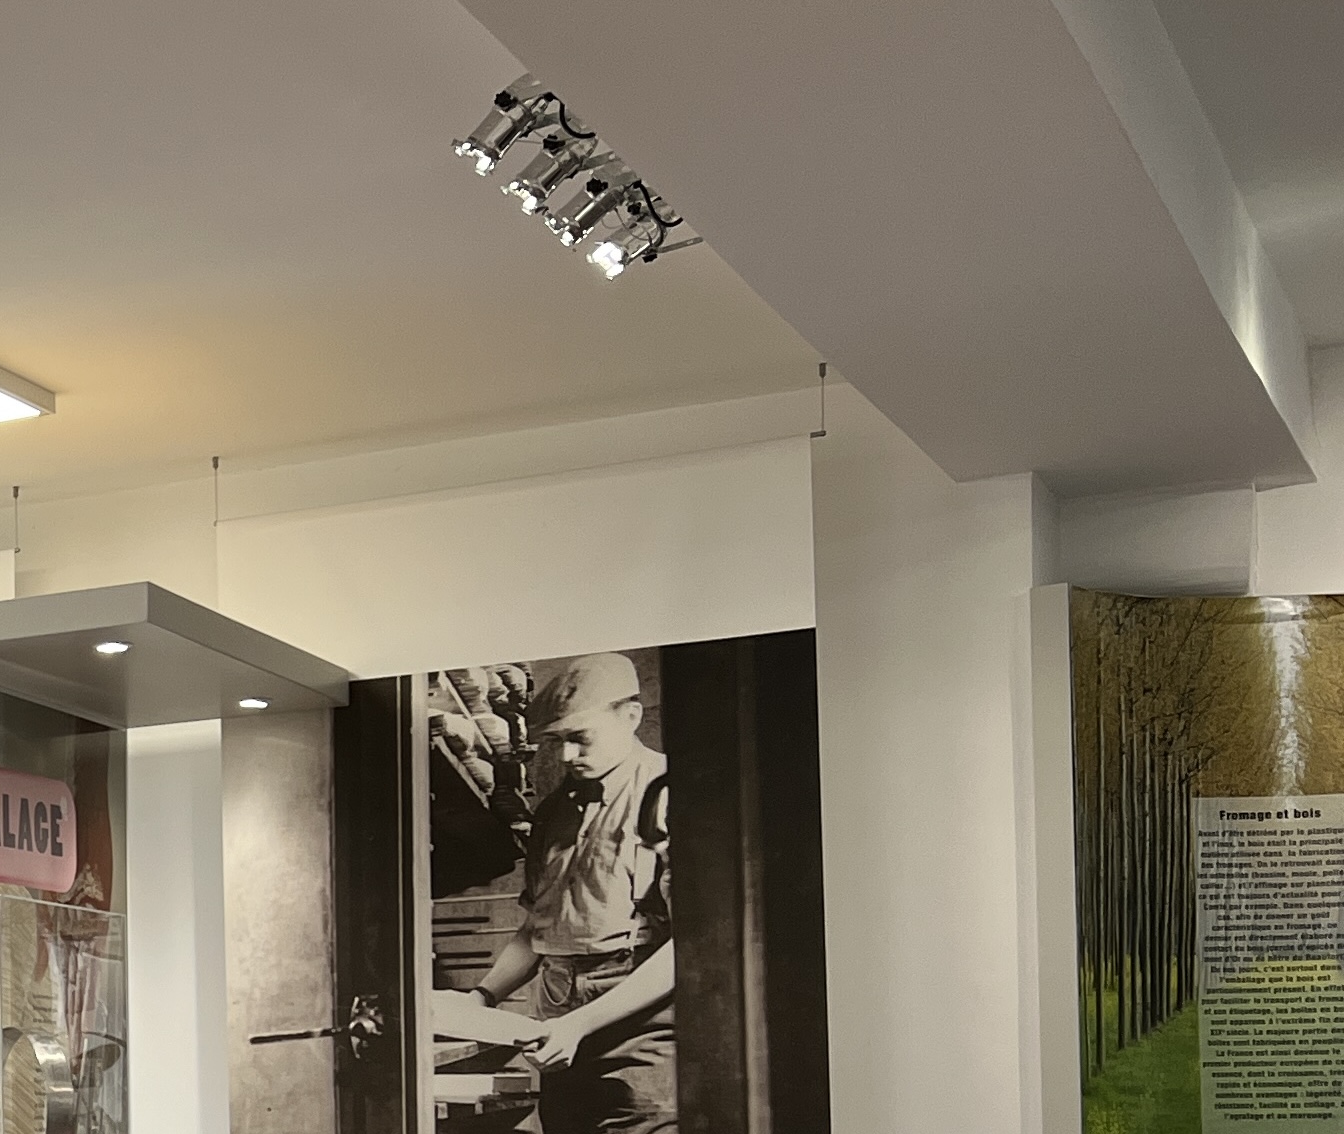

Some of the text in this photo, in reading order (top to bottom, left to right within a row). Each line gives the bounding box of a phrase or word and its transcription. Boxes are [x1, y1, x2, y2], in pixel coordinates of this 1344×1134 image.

[1219, 808, 1321, 821] Fromage et bois
